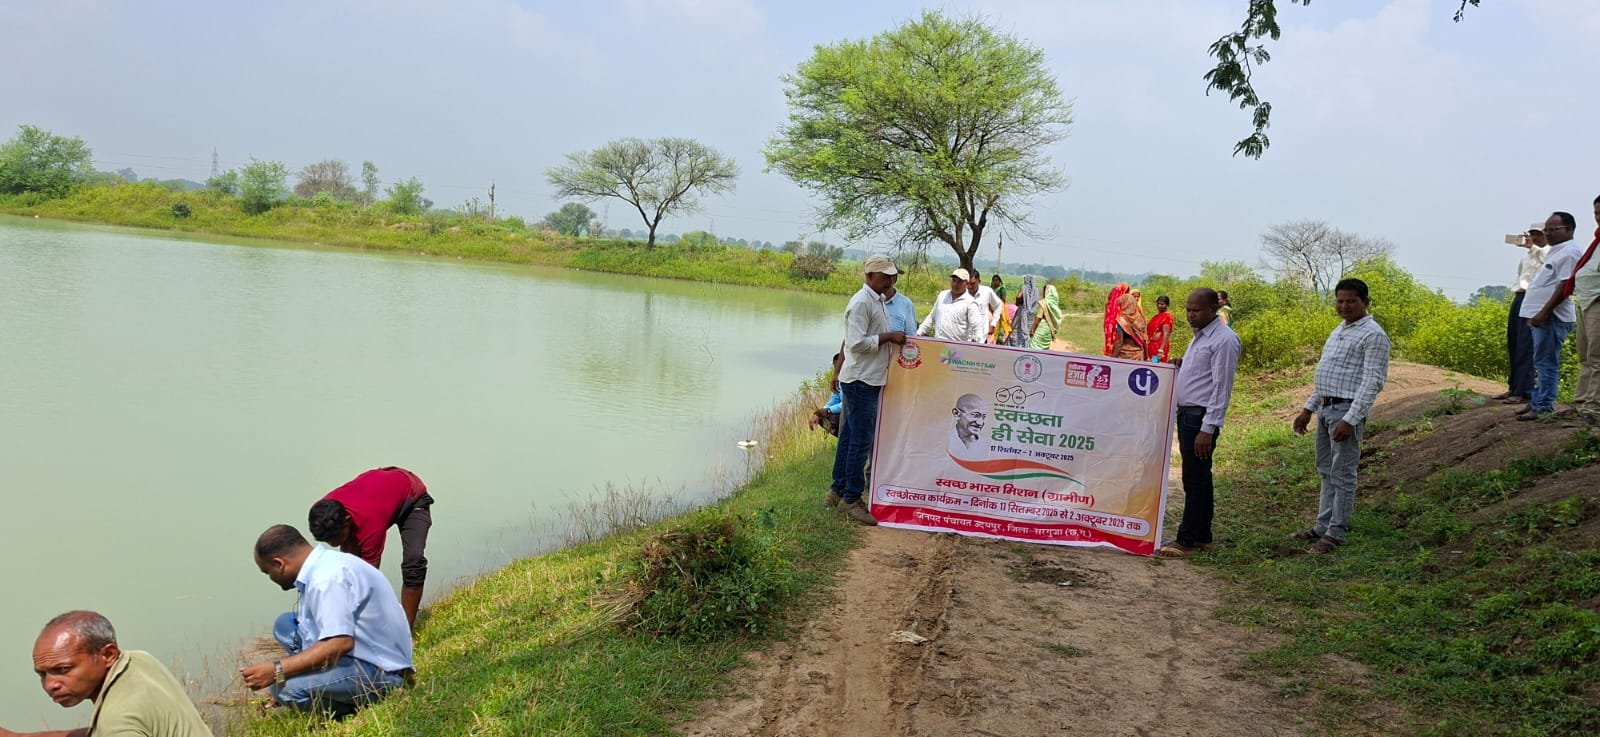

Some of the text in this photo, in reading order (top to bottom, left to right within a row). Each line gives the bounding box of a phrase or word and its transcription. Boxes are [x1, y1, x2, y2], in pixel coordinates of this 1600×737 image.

[994, 408, 1064, 428] स्वच्छता
[991, 423, 1095, 451] ही सेवा 2025
[936, 478, 1095, 507] स्वच्छ भारत मिशन (ग्रामीण)
[885, 489, 926, 501] स्वच्छोत्सव
[927, 494, 962, 506] कार्यक्रम
[970, 497, 997, 510] दिनांक
[1008, 502, 1041, 516] सितम्बर
[1042, 507, 1057, 516] 2025
[1059, 508, 1069, 520] से
[1069, 512, 1074, 520] 2
[1075, 513, 1108, 527] अक्टूबर
[1108, 517, 1124, 527] 2025
[1126, 521, 1141, 530] तक
[916, 511, 941, 521] जनपद
[943, 515, 972, 526] पंचायत
